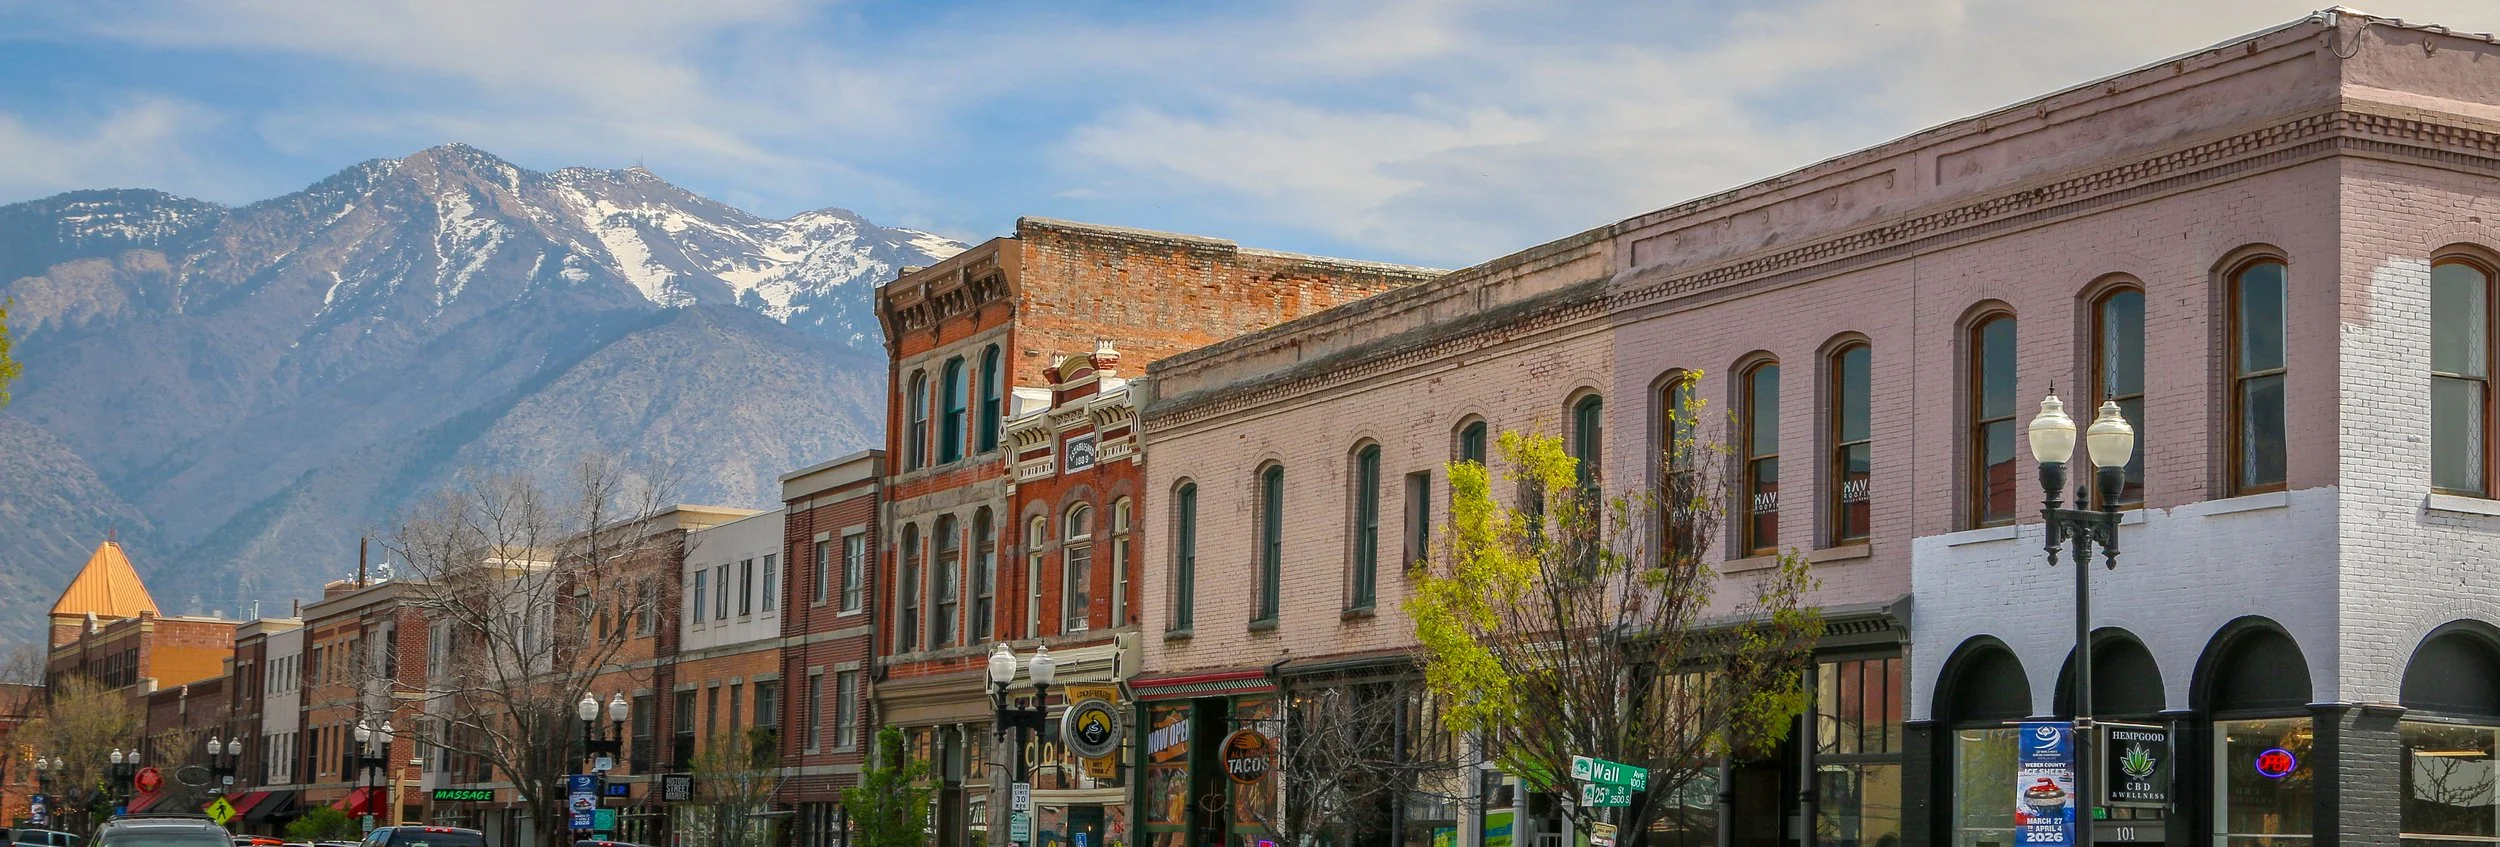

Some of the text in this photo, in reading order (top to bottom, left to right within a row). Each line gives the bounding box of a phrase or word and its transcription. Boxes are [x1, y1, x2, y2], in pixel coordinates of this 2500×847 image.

[1148, 726, 1169, 755] NOW
[2112, 731, 2165, 742] HEMPGOOD
[1228, 757, 1270, 774] TACOS
[1593, 762, 1645, 783] Wall Ave
[1640, 780, 1646, 789] E
[2126, 782, 2151, 791] CBD
[435, 790, 493, 800] MASSAGE
[666, 792, 689, 800] MARKET
[1594, 786, 1625, 803] 25th St
[1610, 796, 1630, 804] 2500 S
[2026, 833, 2064, 842] 2026
[2116, 827, 2135, 841] 101
